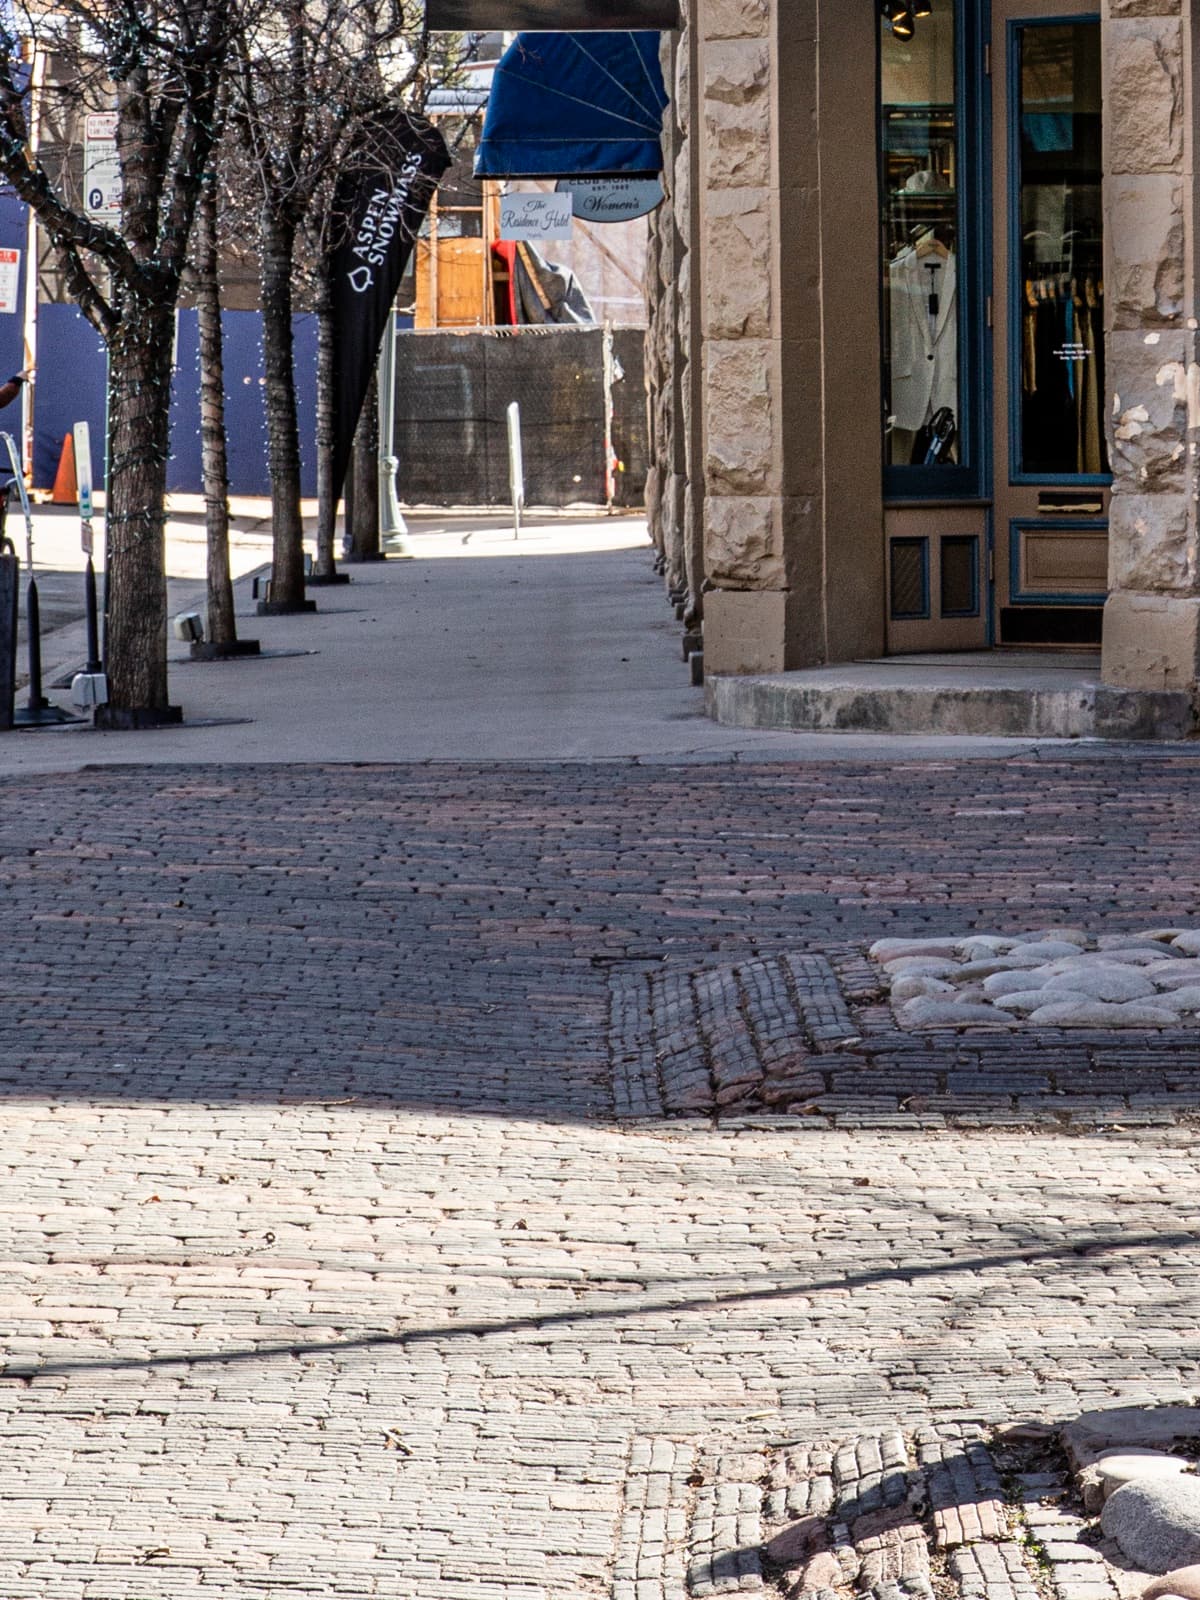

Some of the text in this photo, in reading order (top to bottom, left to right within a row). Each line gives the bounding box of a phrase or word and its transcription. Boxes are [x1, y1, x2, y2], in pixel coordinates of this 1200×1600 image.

[352, 188, 389, 260] ASPEN
[368, 151, 422, 266] SNOWMASS
[522, 200, 547, 212] The
[583, 193, 640, 211] Women's
